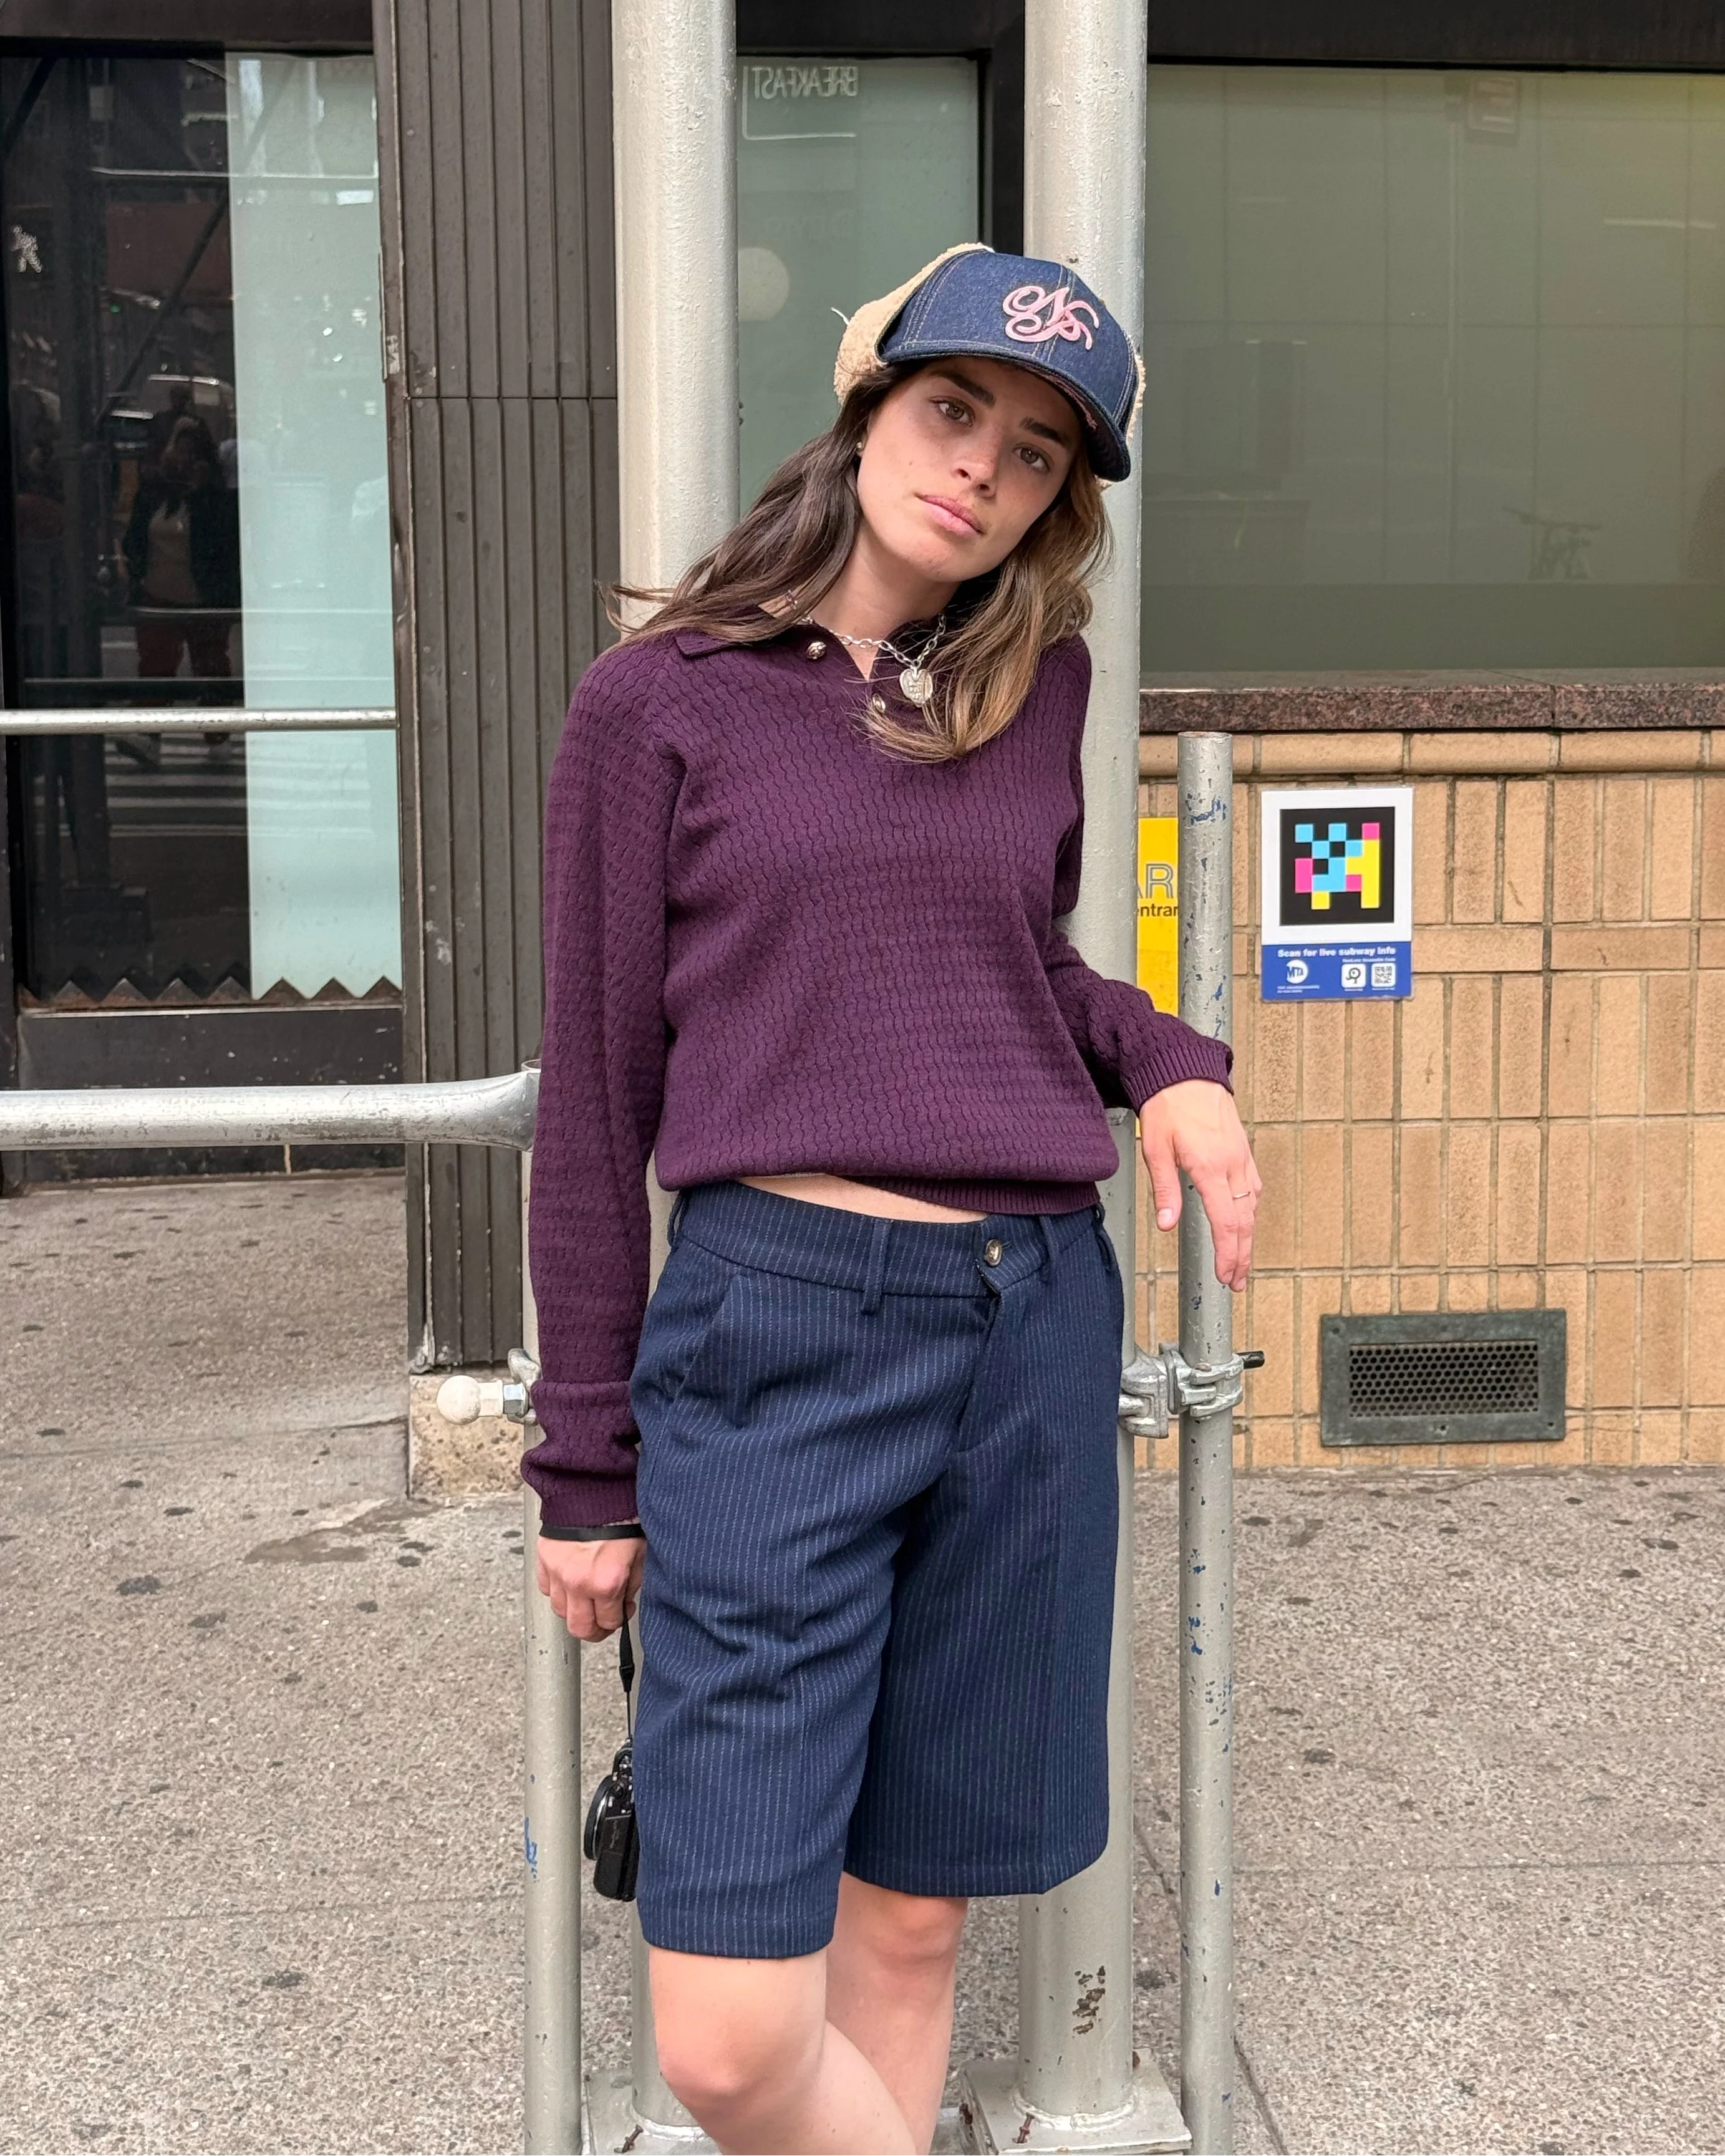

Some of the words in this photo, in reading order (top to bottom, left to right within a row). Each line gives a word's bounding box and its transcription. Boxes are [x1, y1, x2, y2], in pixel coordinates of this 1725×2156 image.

[1138, 863, 1174, 899] R
[1138, 903, 1178, 917] ntra
[1277, 949, 1301, 957] Scan
[1303, 948, 1317, 957] for
[1319, 948, 1336, 957] live
[1338, 947, 1375, 956] subway
[1377, 946, 1396, 955] info
[1287, 966, 1304, 979] MTA
